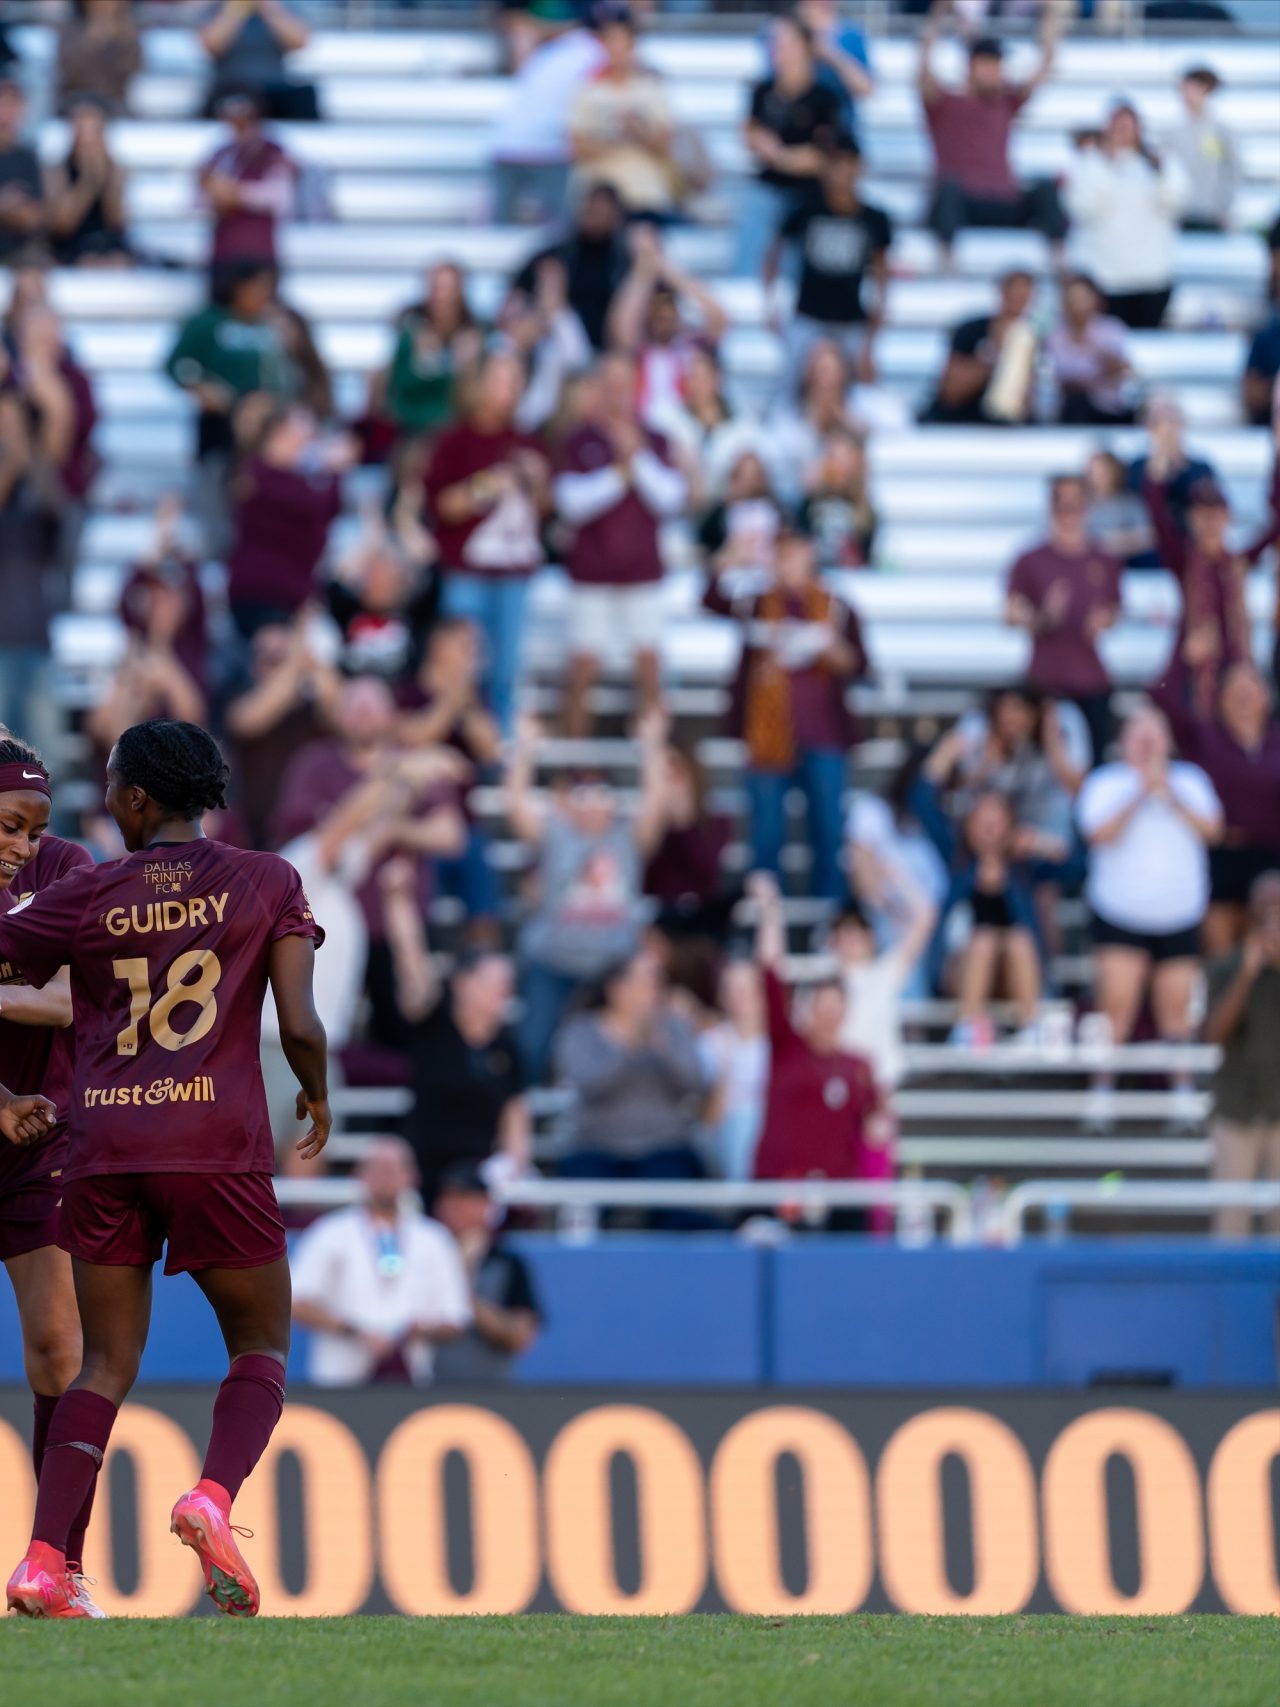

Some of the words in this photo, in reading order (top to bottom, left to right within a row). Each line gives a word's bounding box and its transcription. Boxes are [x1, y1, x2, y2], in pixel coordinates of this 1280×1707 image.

[144, 861, 192, 873] DALLAS
[142, 870, 193, 884] TRINITY
[155, 883, 170, 894] FC
[105, 892, 230, 936] GUIDRY
[112, 949, 222, 1056] 18
